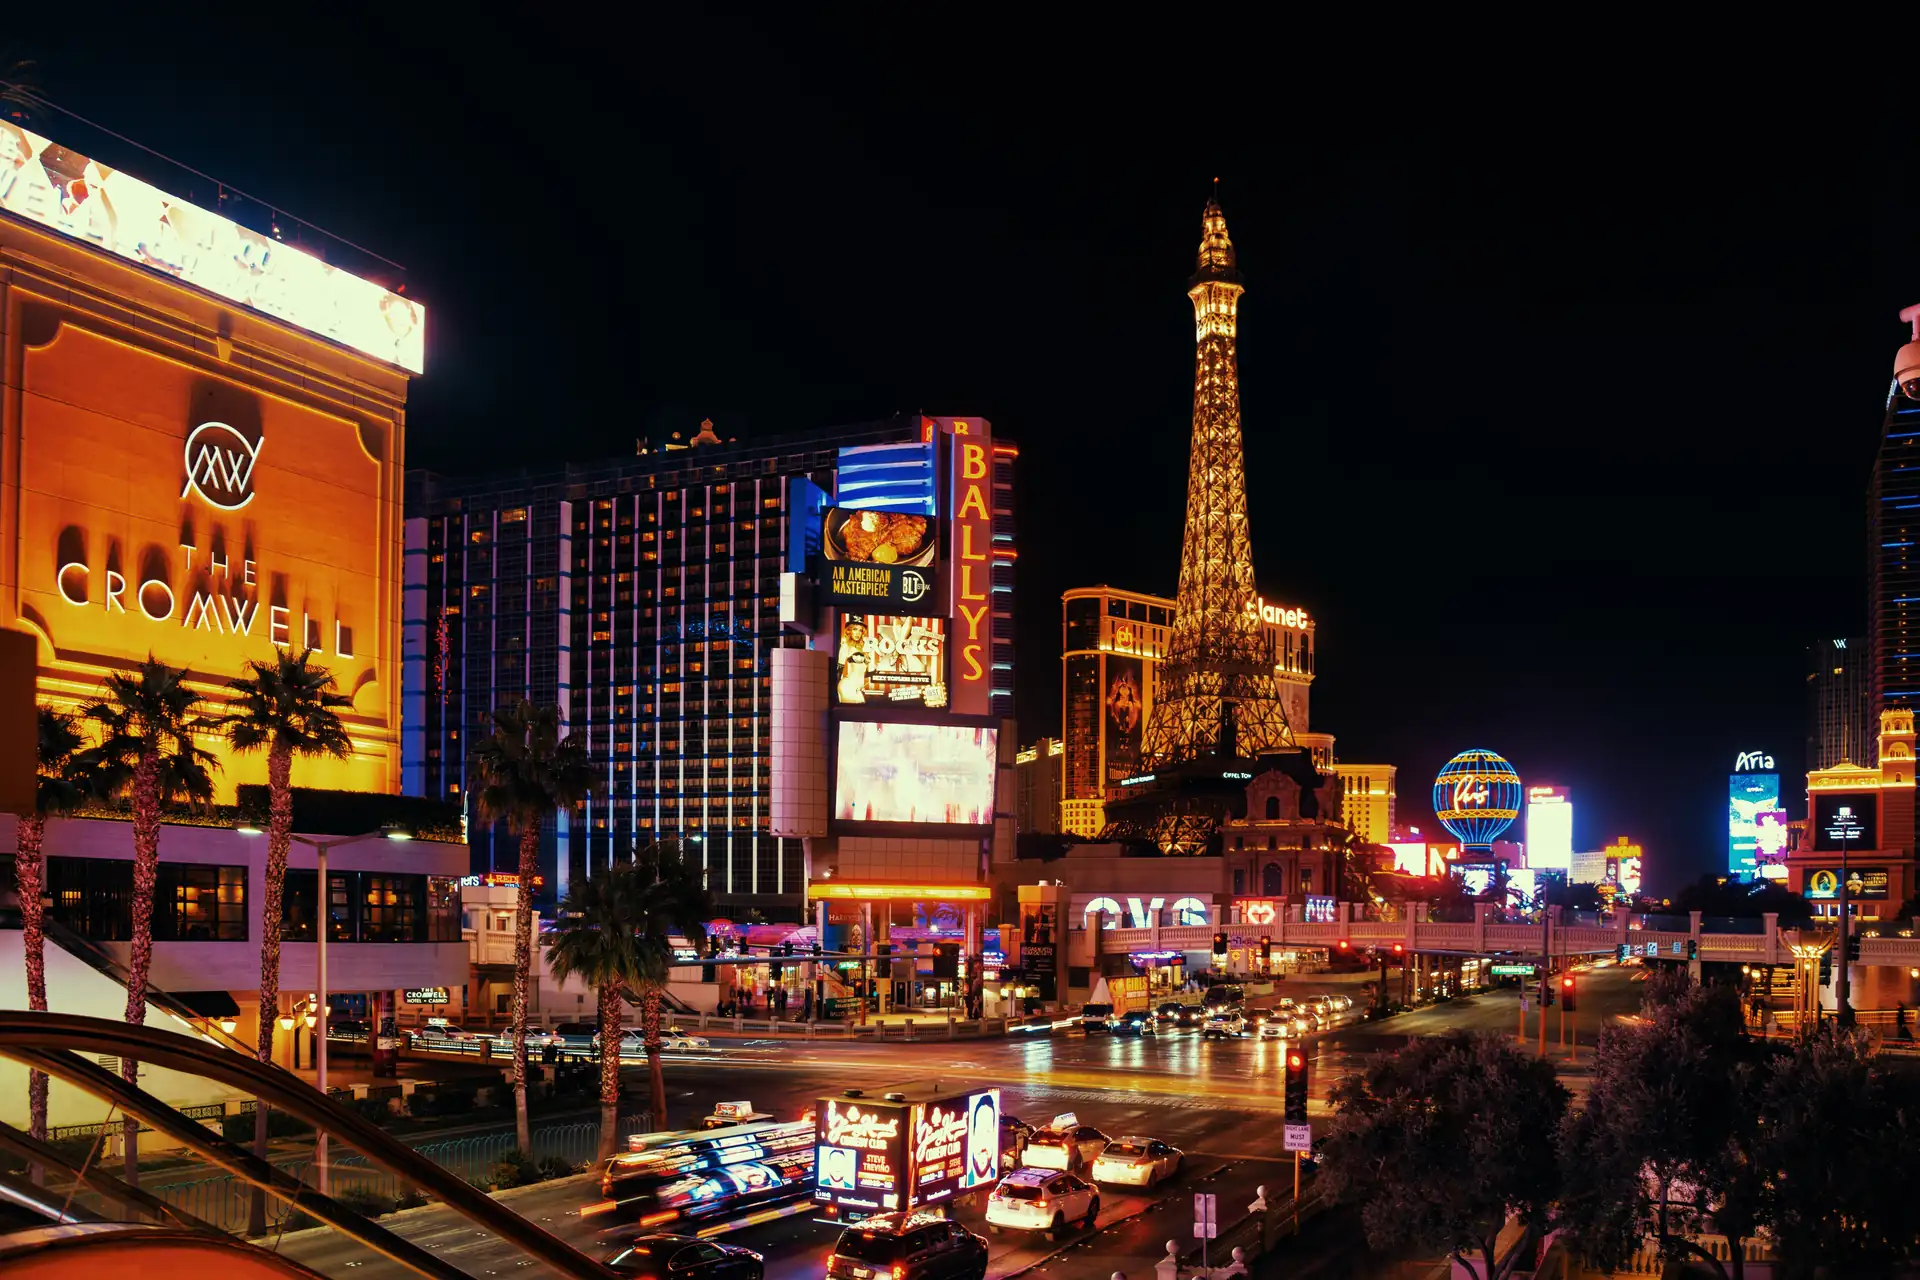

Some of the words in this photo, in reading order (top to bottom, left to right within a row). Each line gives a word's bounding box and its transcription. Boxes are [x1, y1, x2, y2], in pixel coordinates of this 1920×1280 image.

[179, 543, 258, 587] THE
[957, 443, 990, 682] BALLYS
[832, 566, 845, 580] AN
[848, 567, 891, 584] AMERICAN
[832, 579, 889, 597] MASTERPIECE
[902, 576, 919, 595] BLT
[56, 561, 355, 660] CROMWELL
[1735, 750, 1775, 772] Aria
[1453, 774, 1489, 814] Paris
[1083, 896, 1208, 930] CVS
[1290, 1133, 1305, 1141] MUST
[862, 1161, 890, 1173] TREVIÑO
[866, 1154, 886, 1164] STEVE
